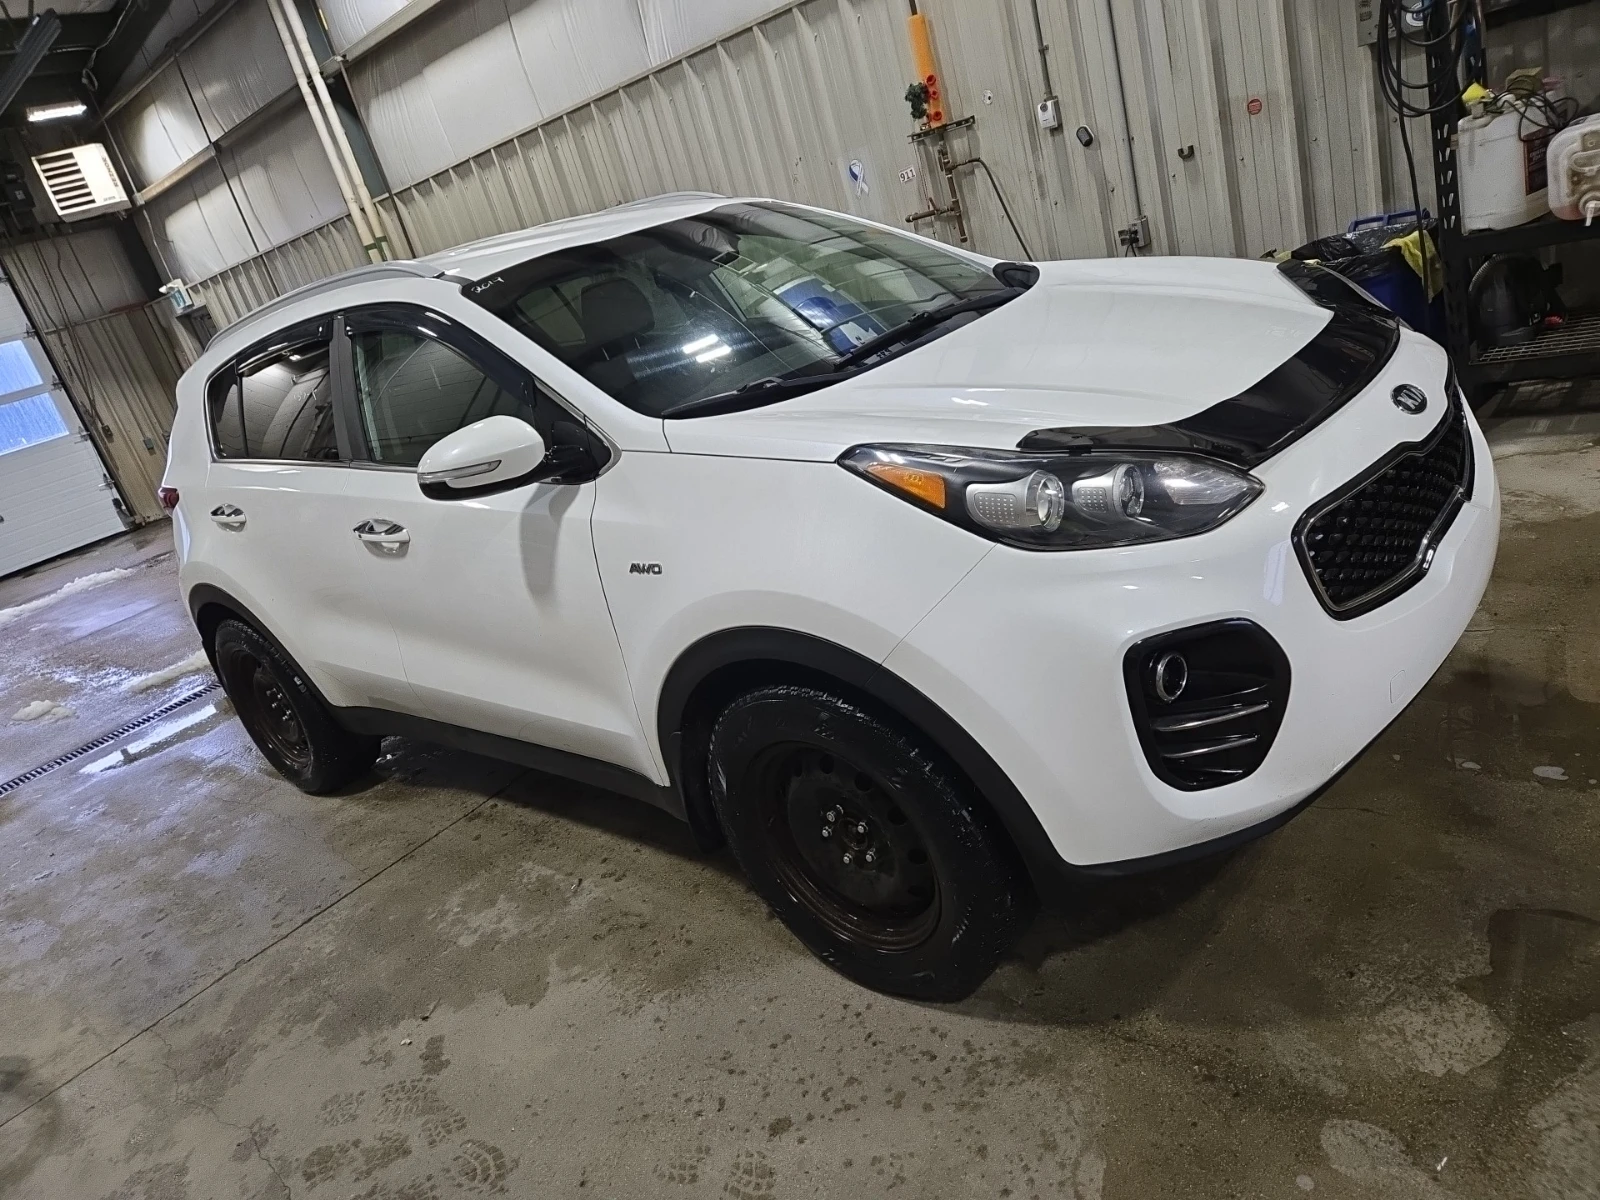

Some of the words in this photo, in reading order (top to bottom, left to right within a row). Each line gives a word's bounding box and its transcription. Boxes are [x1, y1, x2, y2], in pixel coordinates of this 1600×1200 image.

[899, 168, 916, 182] 911
[1396, 385, 1426, 410] KIA
[629, 562, 663, 575] AWD
